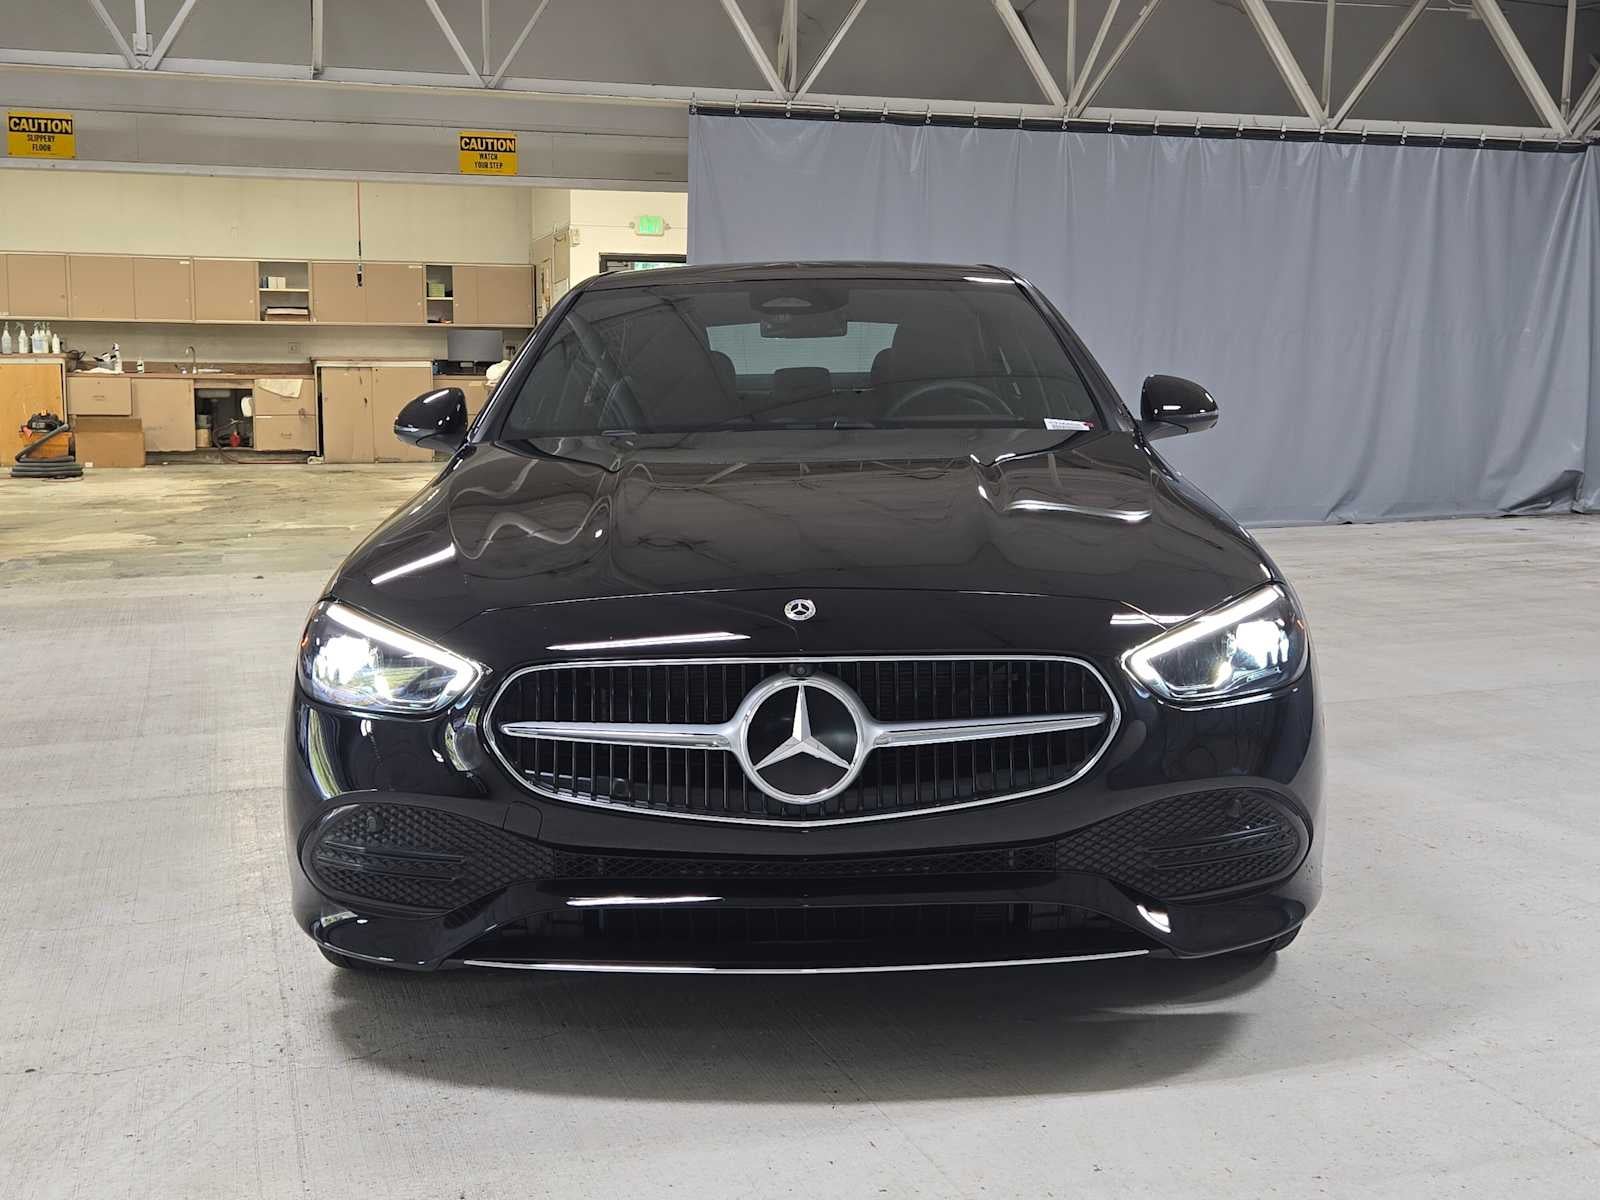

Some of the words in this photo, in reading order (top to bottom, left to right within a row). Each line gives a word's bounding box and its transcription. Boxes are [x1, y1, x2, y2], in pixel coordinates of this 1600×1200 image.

[10, 117, 72, 133] CAUTION
[27, 134, 55, 142] SLIPPERY
[32, 144, 52, 152] FLOOR
[461, 138, 515, 151] CAUTION
